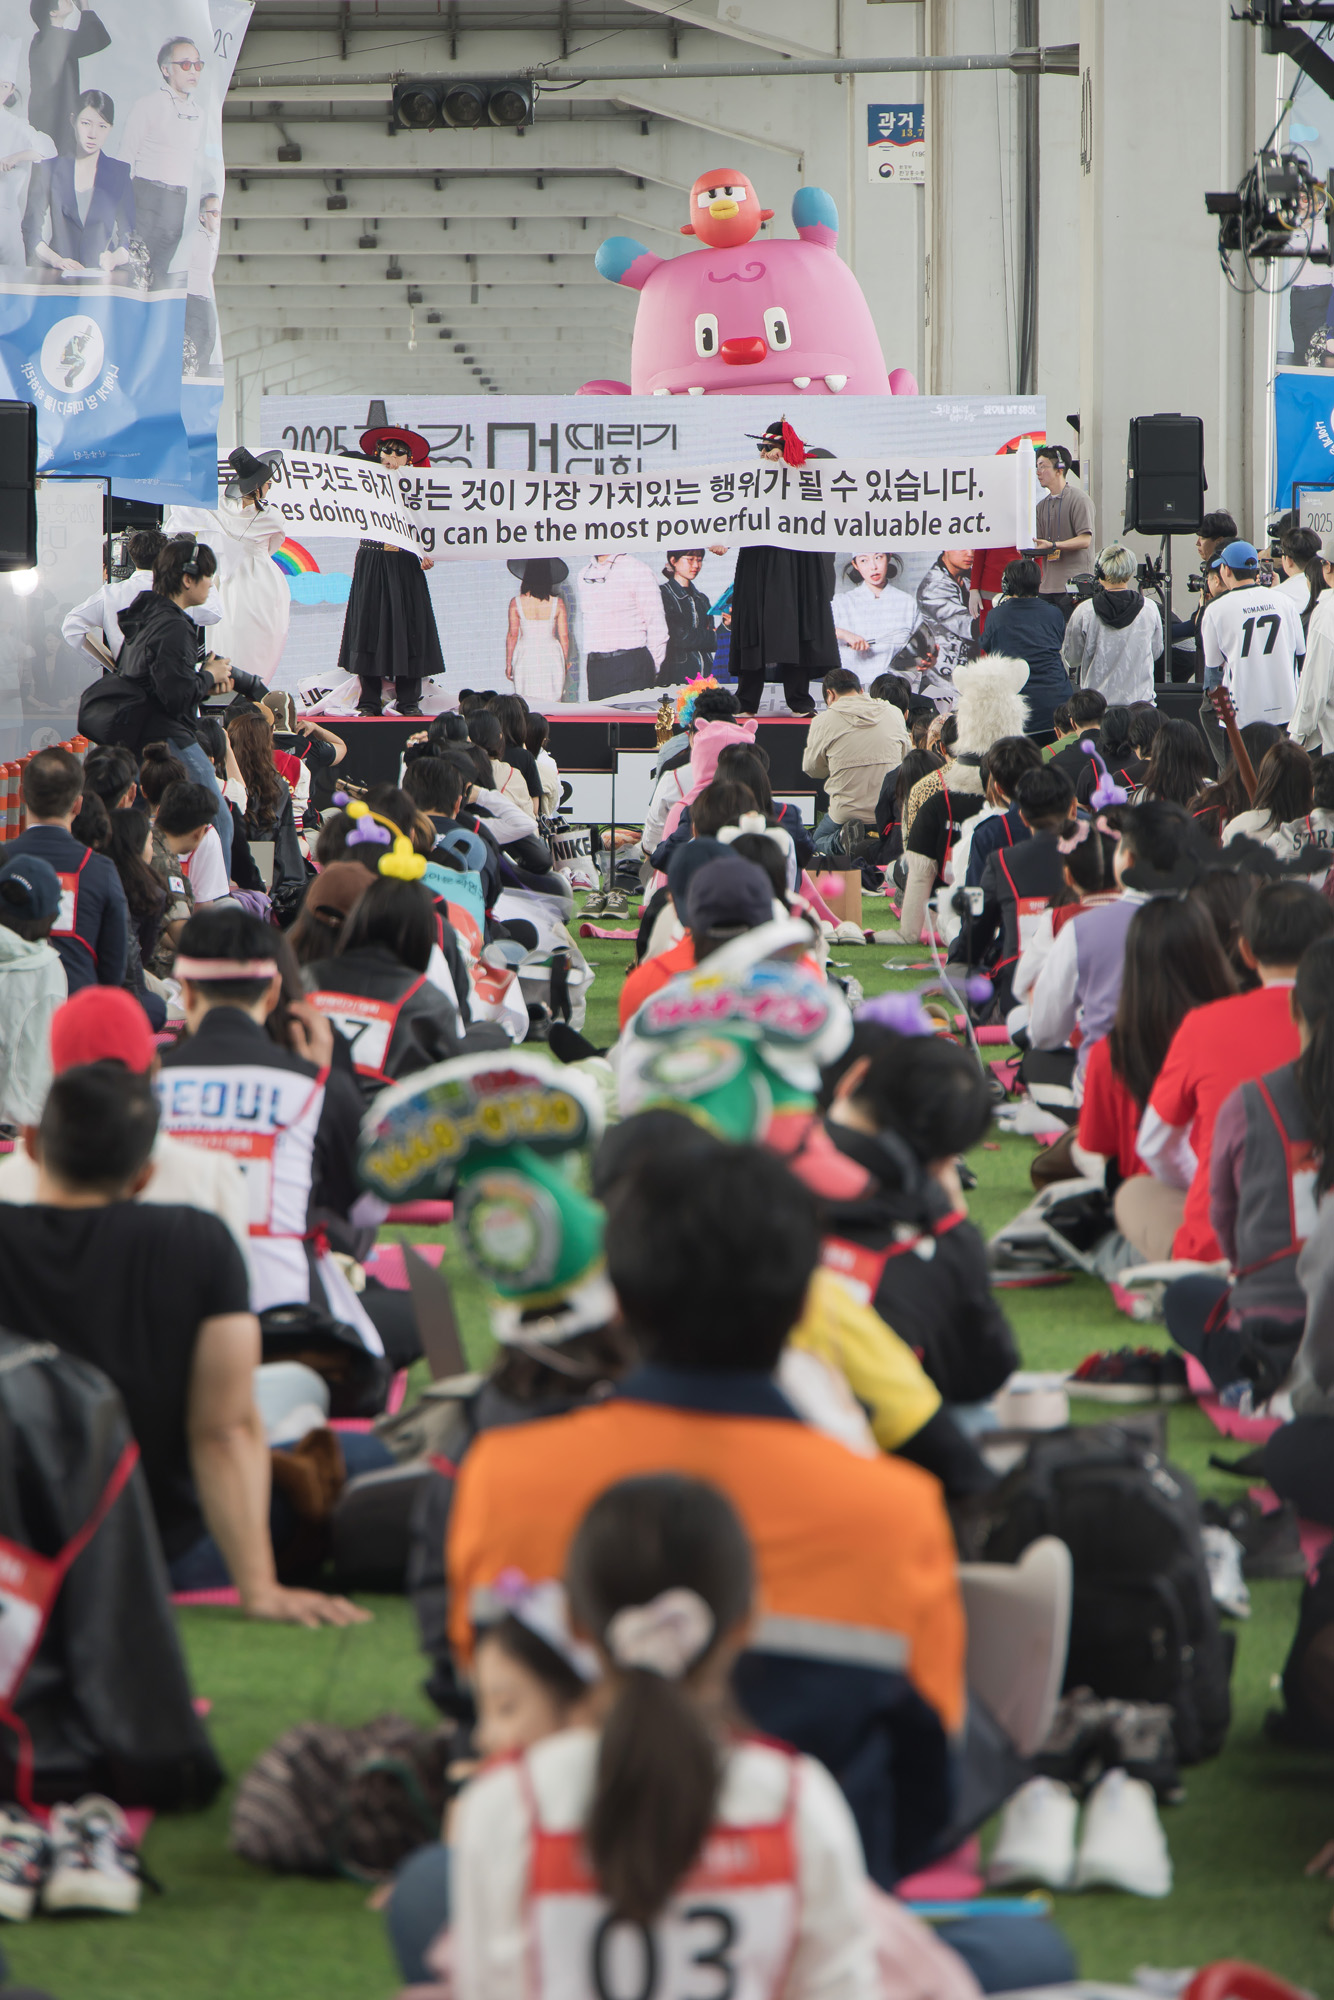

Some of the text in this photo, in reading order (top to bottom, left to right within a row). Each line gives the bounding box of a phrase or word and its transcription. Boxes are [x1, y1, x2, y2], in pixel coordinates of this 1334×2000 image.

[878, 111, 914, 129] 과거
[357, 468, 397, 505] 하지
[398, 477, 453, 512] 않는
[461, 479, 515, 512] 것이
[524, 479, 581, 512] 가장
[588, 478, 702, 510] 가치있는
[709, 467, 791, 504] 행위가
[798, 469, 824, 502] 될
[830, 470, 858, 503] 수
[865, 467, 985, 503] 있습니다.
[309, 497, 369, 531] doing
[369, 509, 437, 553] nothing
[443, 525, 489, 546] can
[496, 518, 528, 544] be
[534, 517, 578, 543] the
[584, 517, 650, 541] most
[656, 506, 771, 543] powerful
[777, 510, 826, 536] and
[833, 510, 943, 537] valuable
[948, 511, 992, 535] act.
[1240, 613, 1282, 659] 17
[552, 836, 592, 862] NIKE
